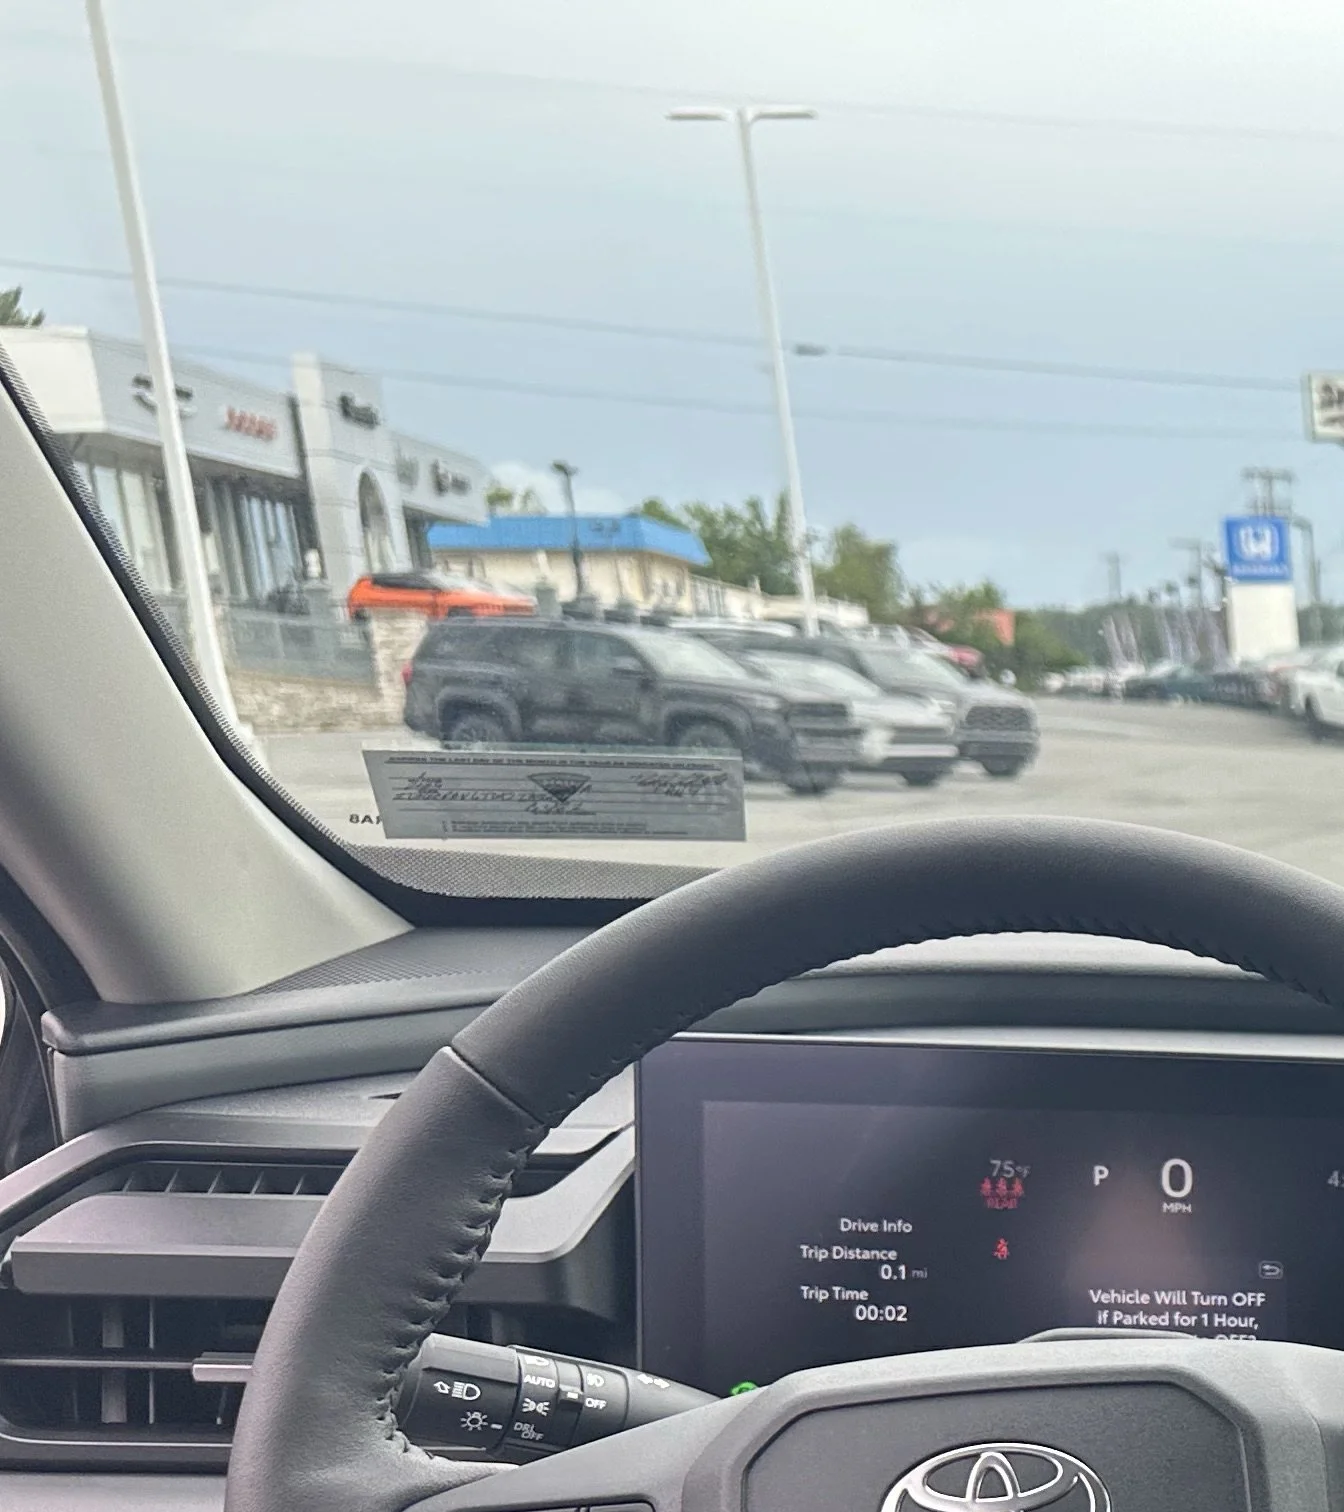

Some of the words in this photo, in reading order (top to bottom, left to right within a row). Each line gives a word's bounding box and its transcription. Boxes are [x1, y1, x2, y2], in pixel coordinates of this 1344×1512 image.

[1093, 1166, 1109, 1186] P
[1161, 1158, 1194, 1198] 0
[1162, 1201, 1192, 1213] MPH
[840, 1218, 878, 1233] Drive
[883, 1218, 912, 1233] Info
[800, 1245, 829, 1262] Trip
[832, 1246, 898, 1261] Distance
[880, 1264, 907, 1280] 0.1
[912, 1267, 928, 1279] mi
[800, 1286, 829, 1302] Trip
[832, 1287, 868, 1301] Time
[1090, 1289, 1150, 1306] Vehicle
[1154, 1290, 1187, 1306] Will
[1191, 1291, 1228, 1306] Turn
[1232, 1291, 1266, 1307] OFF
[855, 1305, 908, 1323] 00:02
[1097, 1311, 1109, 1326] If
[1113, 1311, 1169, 1328] Parked
[1173, 1312, 1197, 1327] for
[1201, 1313, 1209, 1327] 1
[1213, 1313, 1259, 1330] Hour,
[524, 1374, 556, 1388] AUTO
[585, 1398, 607, 1410] OFF
[521, 1431, 544, 1441] OFF
